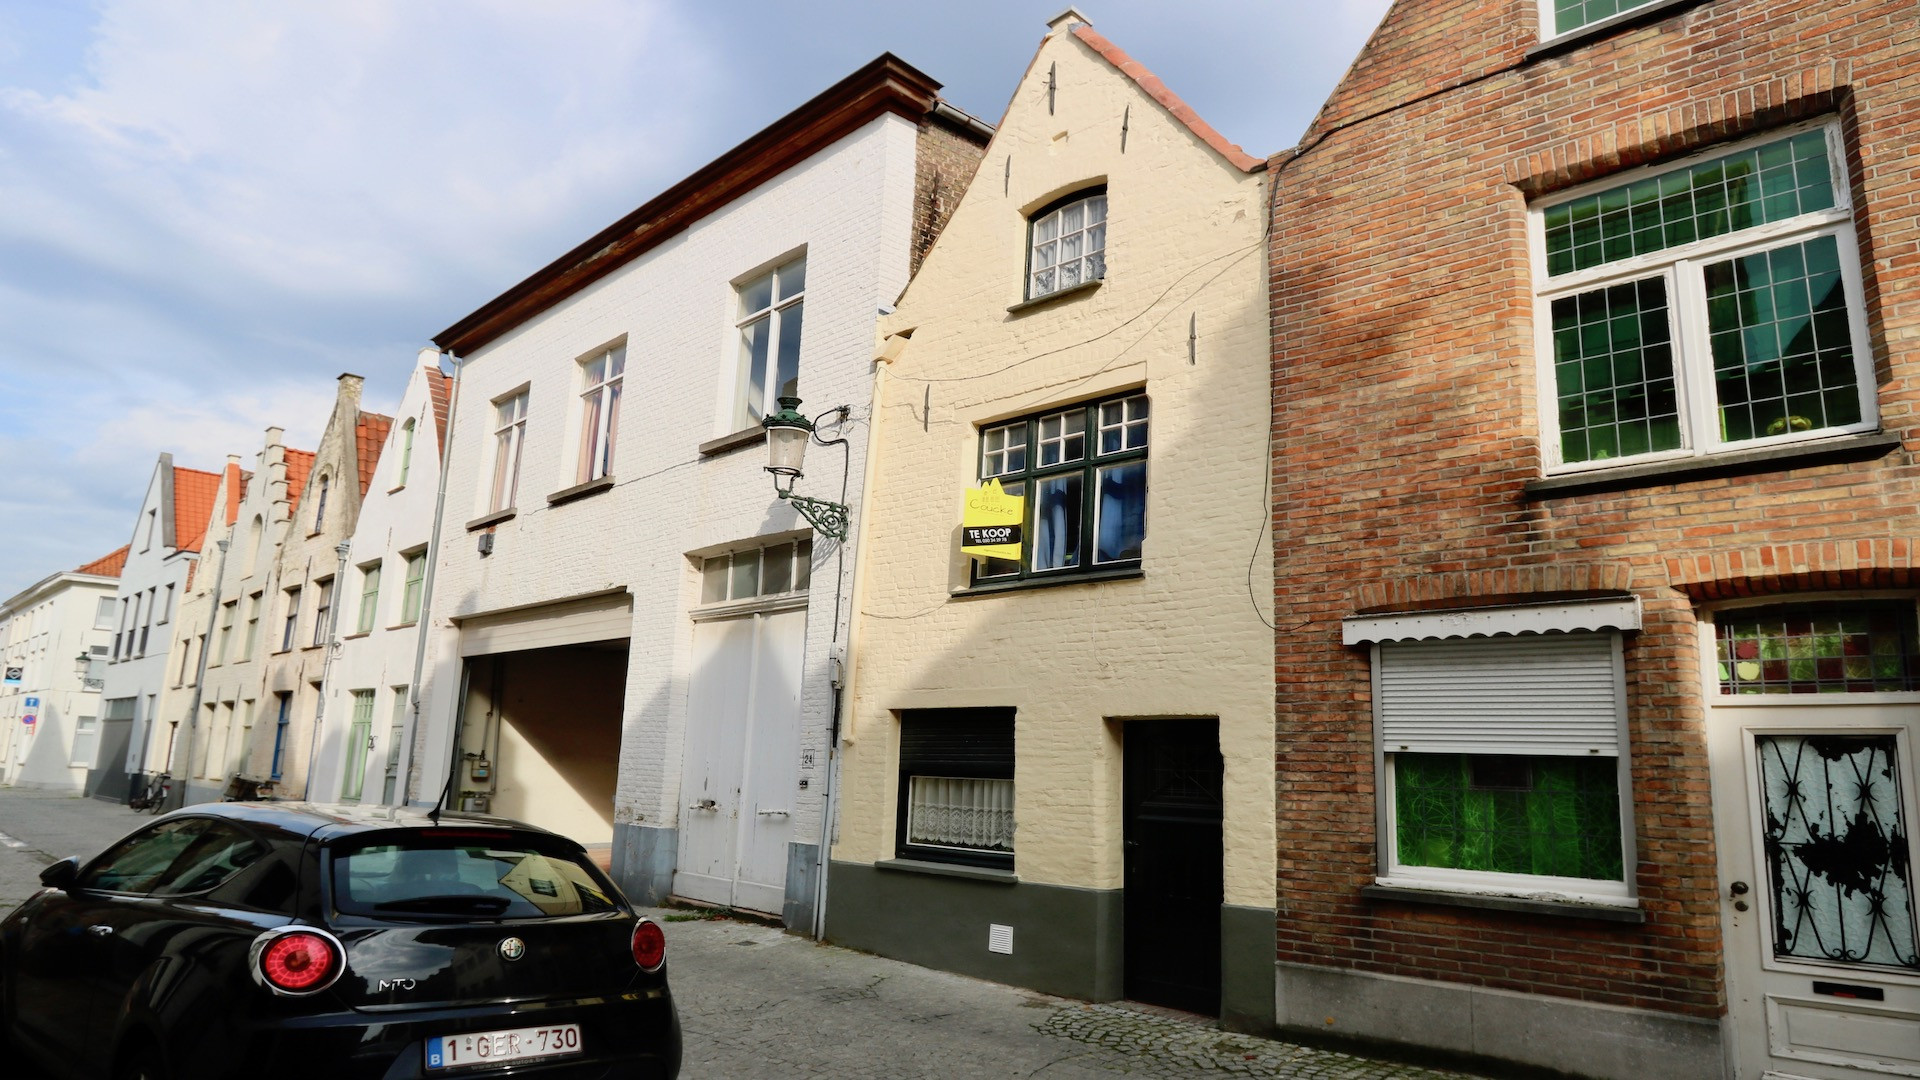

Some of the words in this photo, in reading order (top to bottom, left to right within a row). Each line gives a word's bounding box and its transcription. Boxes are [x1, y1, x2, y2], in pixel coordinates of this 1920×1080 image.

[968, 530, 980, 539] TE
[982, 528, 1011, 538] KOOP
[804, 754, 812, 764] 24
[430, 1054, 440, 1065] B
